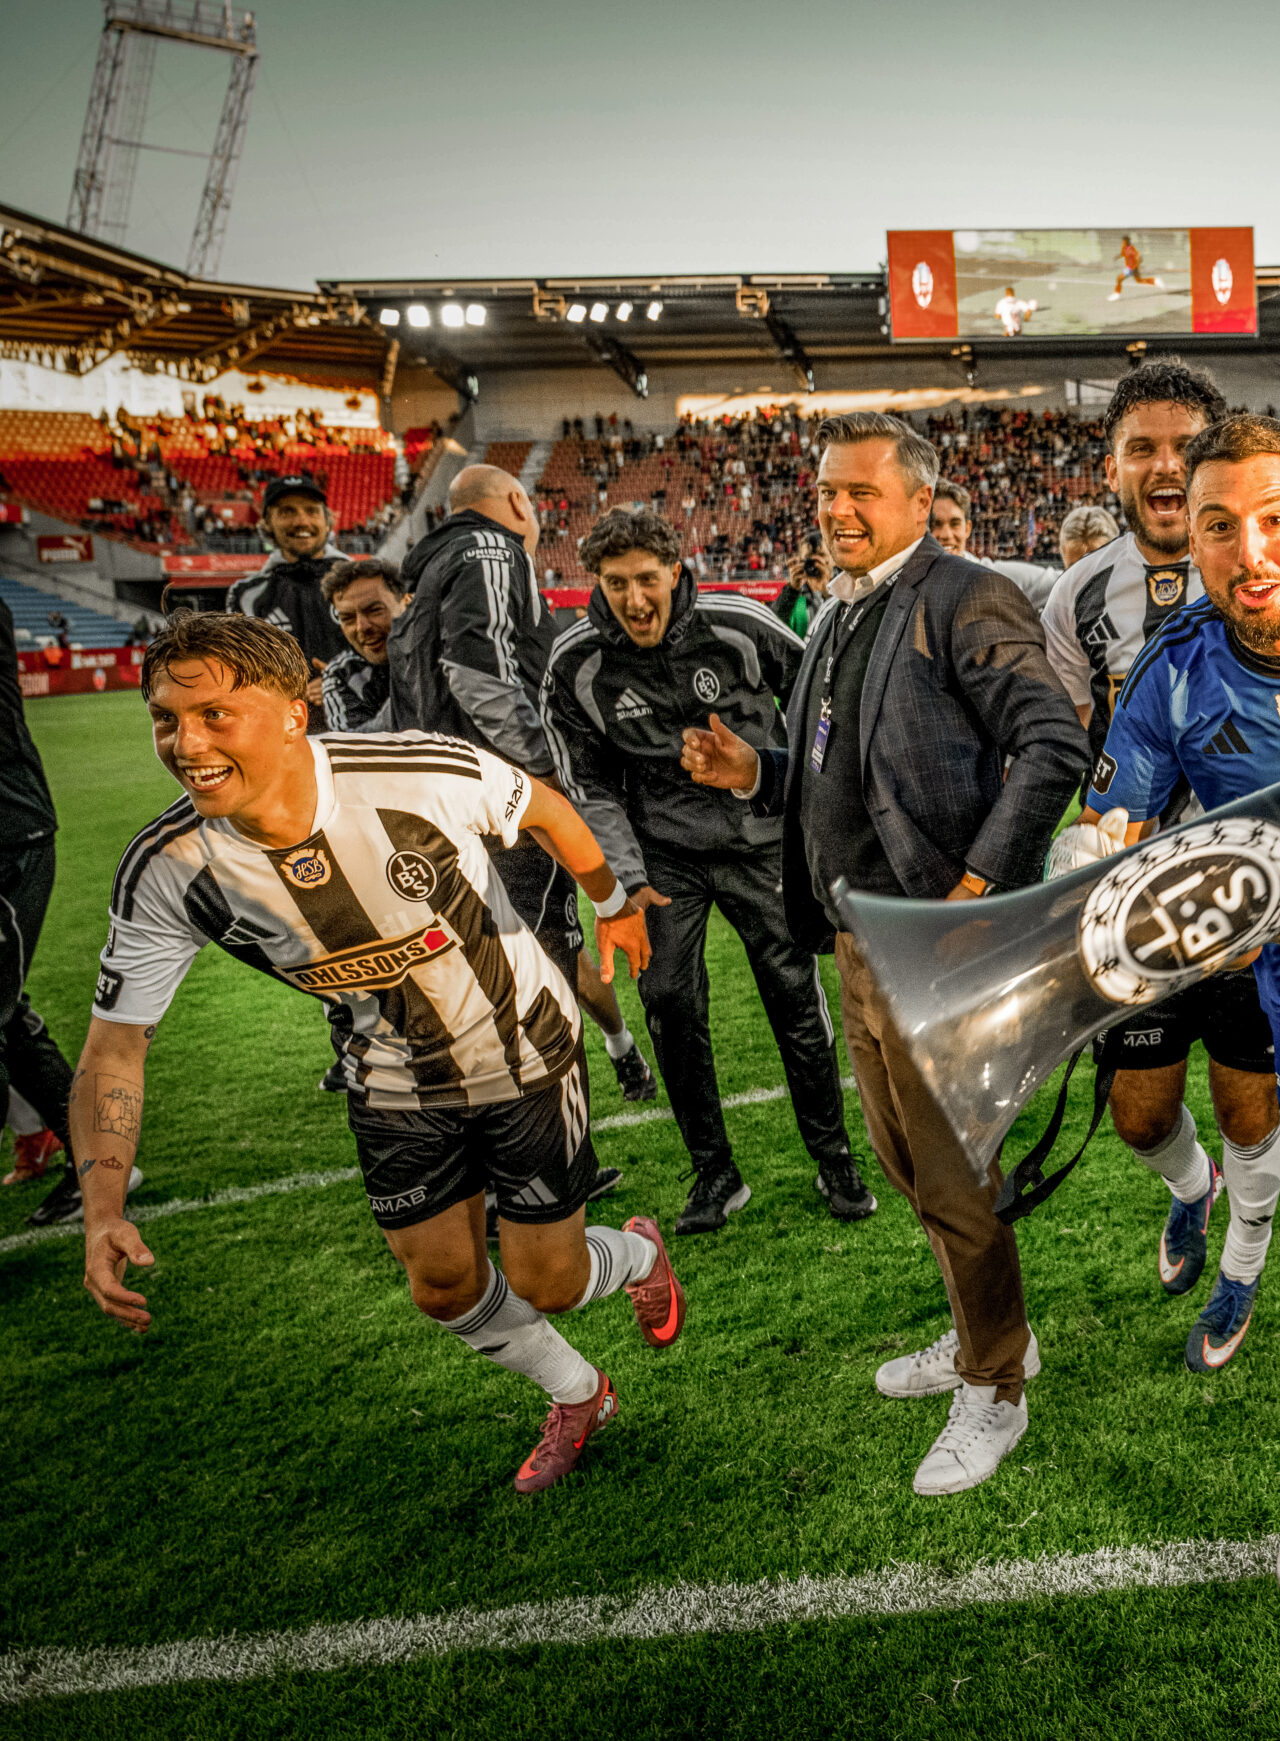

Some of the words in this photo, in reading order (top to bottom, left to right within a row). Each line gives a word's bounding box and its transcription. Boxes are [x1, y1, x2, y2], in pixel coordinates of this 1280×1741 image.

[466, 547, 511, 559] UNIBET
[295, 859, 323, 880] HSB
[295, 941, 427, 986] OHLSSONS
